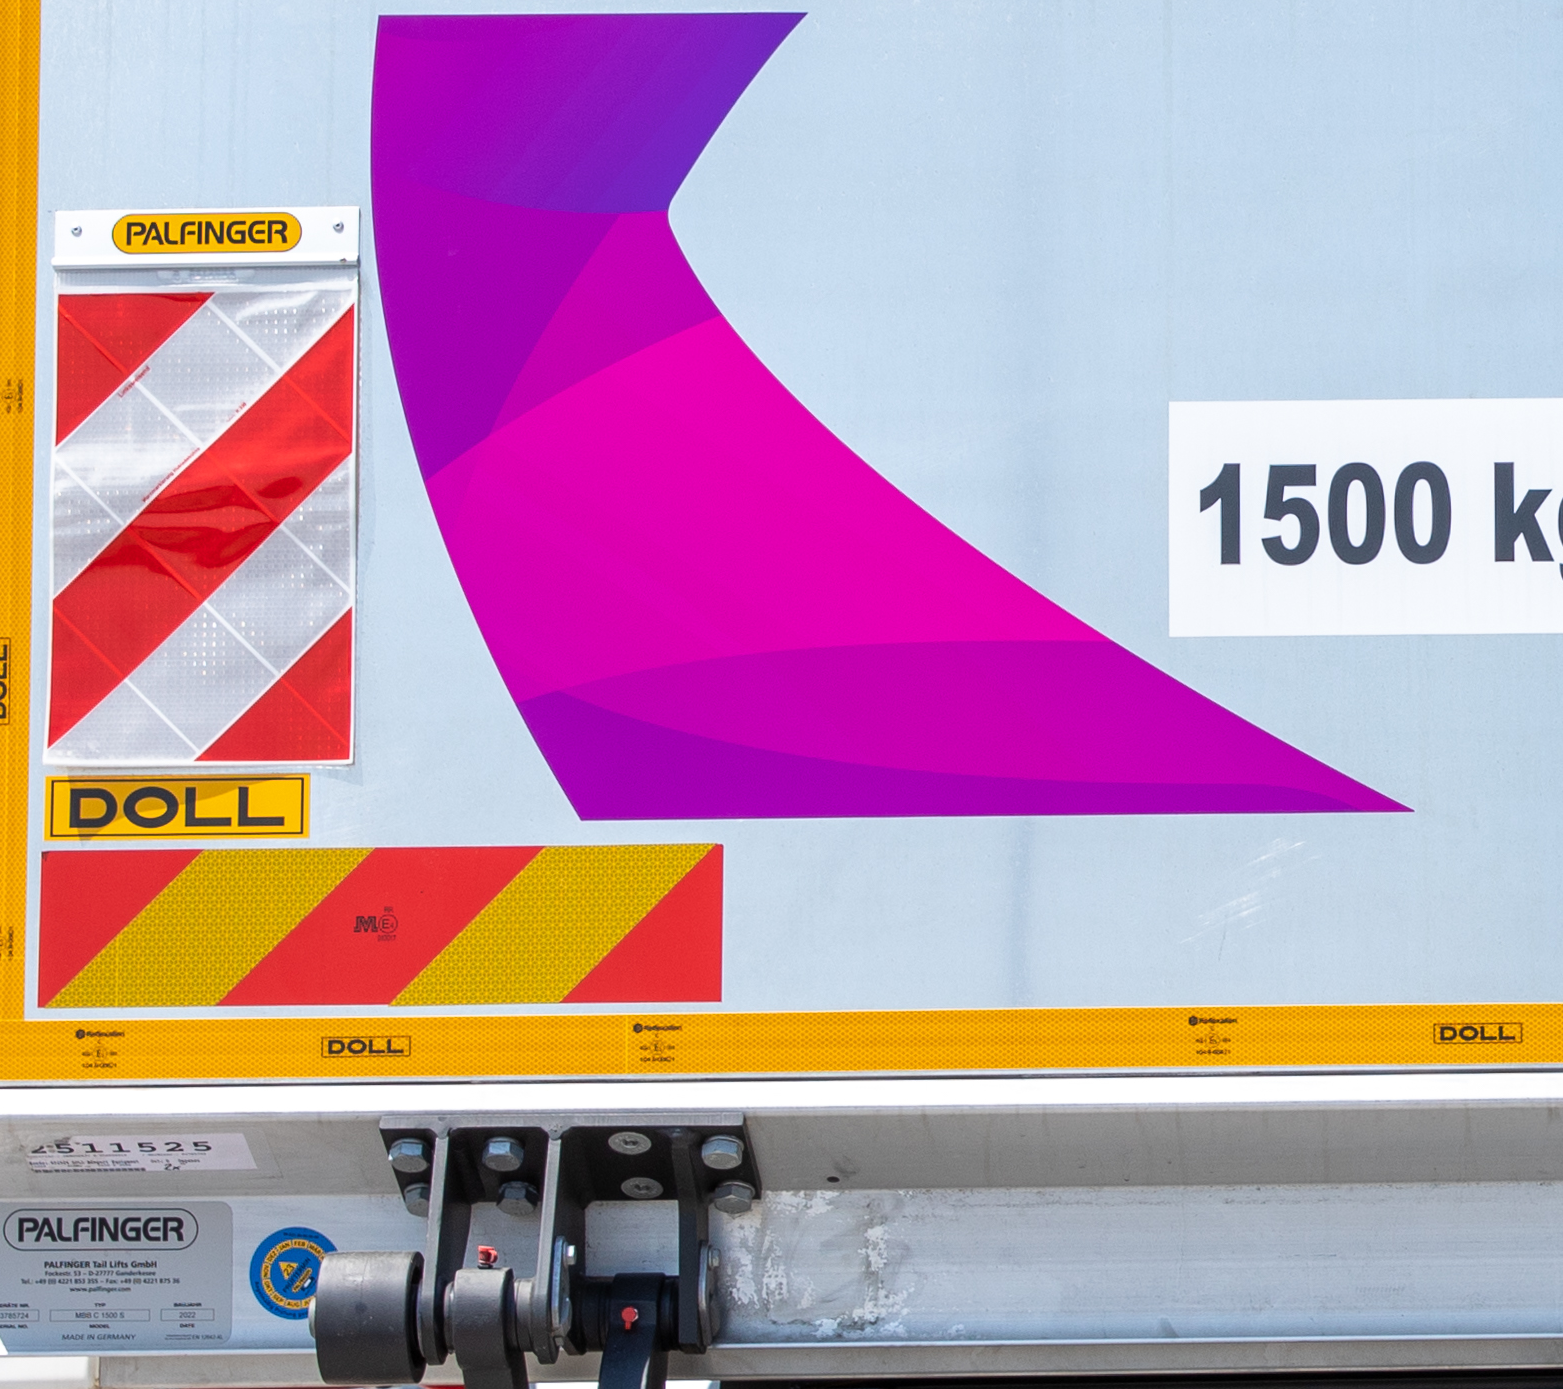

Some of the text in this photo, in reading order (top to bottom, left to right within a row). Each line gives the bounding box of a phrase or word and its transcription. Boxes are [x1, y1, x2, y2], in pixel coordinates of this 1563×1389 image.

[126, 220, 288, 246] PALFINGER
[1199, 462, 1452, 565] 1500
[68, 786, 285, 829] DOLL
[1440, 1024, 1516, 1041] DOLL
[328, 1038, 404, 1055] DOLL
[18, 1216, 184, 1242] PALFINGER
[44, 1260, 158, 1268] PALFINGER Tail Lifts GmbH
[179, 1311, 196, 1319] 2022
[98, 1333, 137, 1341] GERMANY
